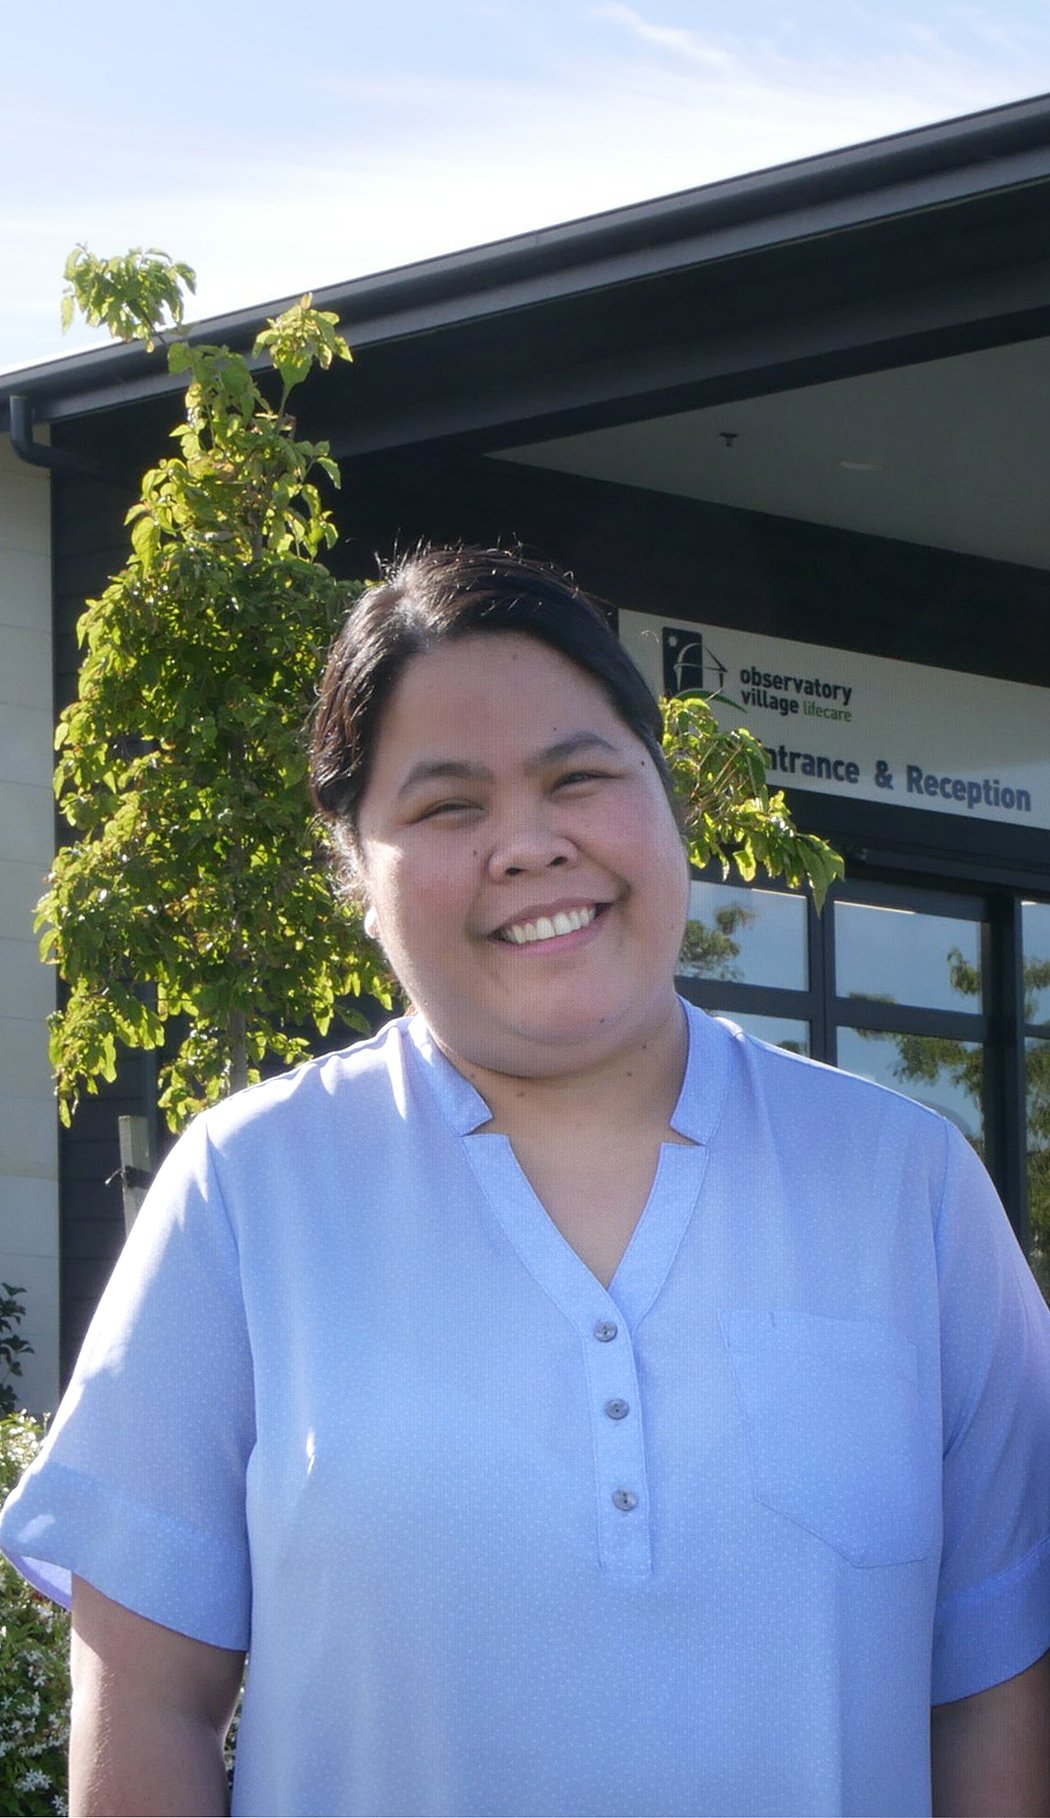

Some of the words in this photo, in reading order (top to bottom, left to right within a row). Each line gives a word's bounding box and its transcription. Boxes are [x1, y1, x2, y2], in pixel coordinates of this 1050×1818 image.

[740, 666, 852, 706] observatory
[741, 690, 799, 716] village
[803, 701, 852, 722] lifecare
[757, 739, 860, 784] ntrance
[874, 759, 894, 790] &
[906, 764, 1032, 812] Reception
